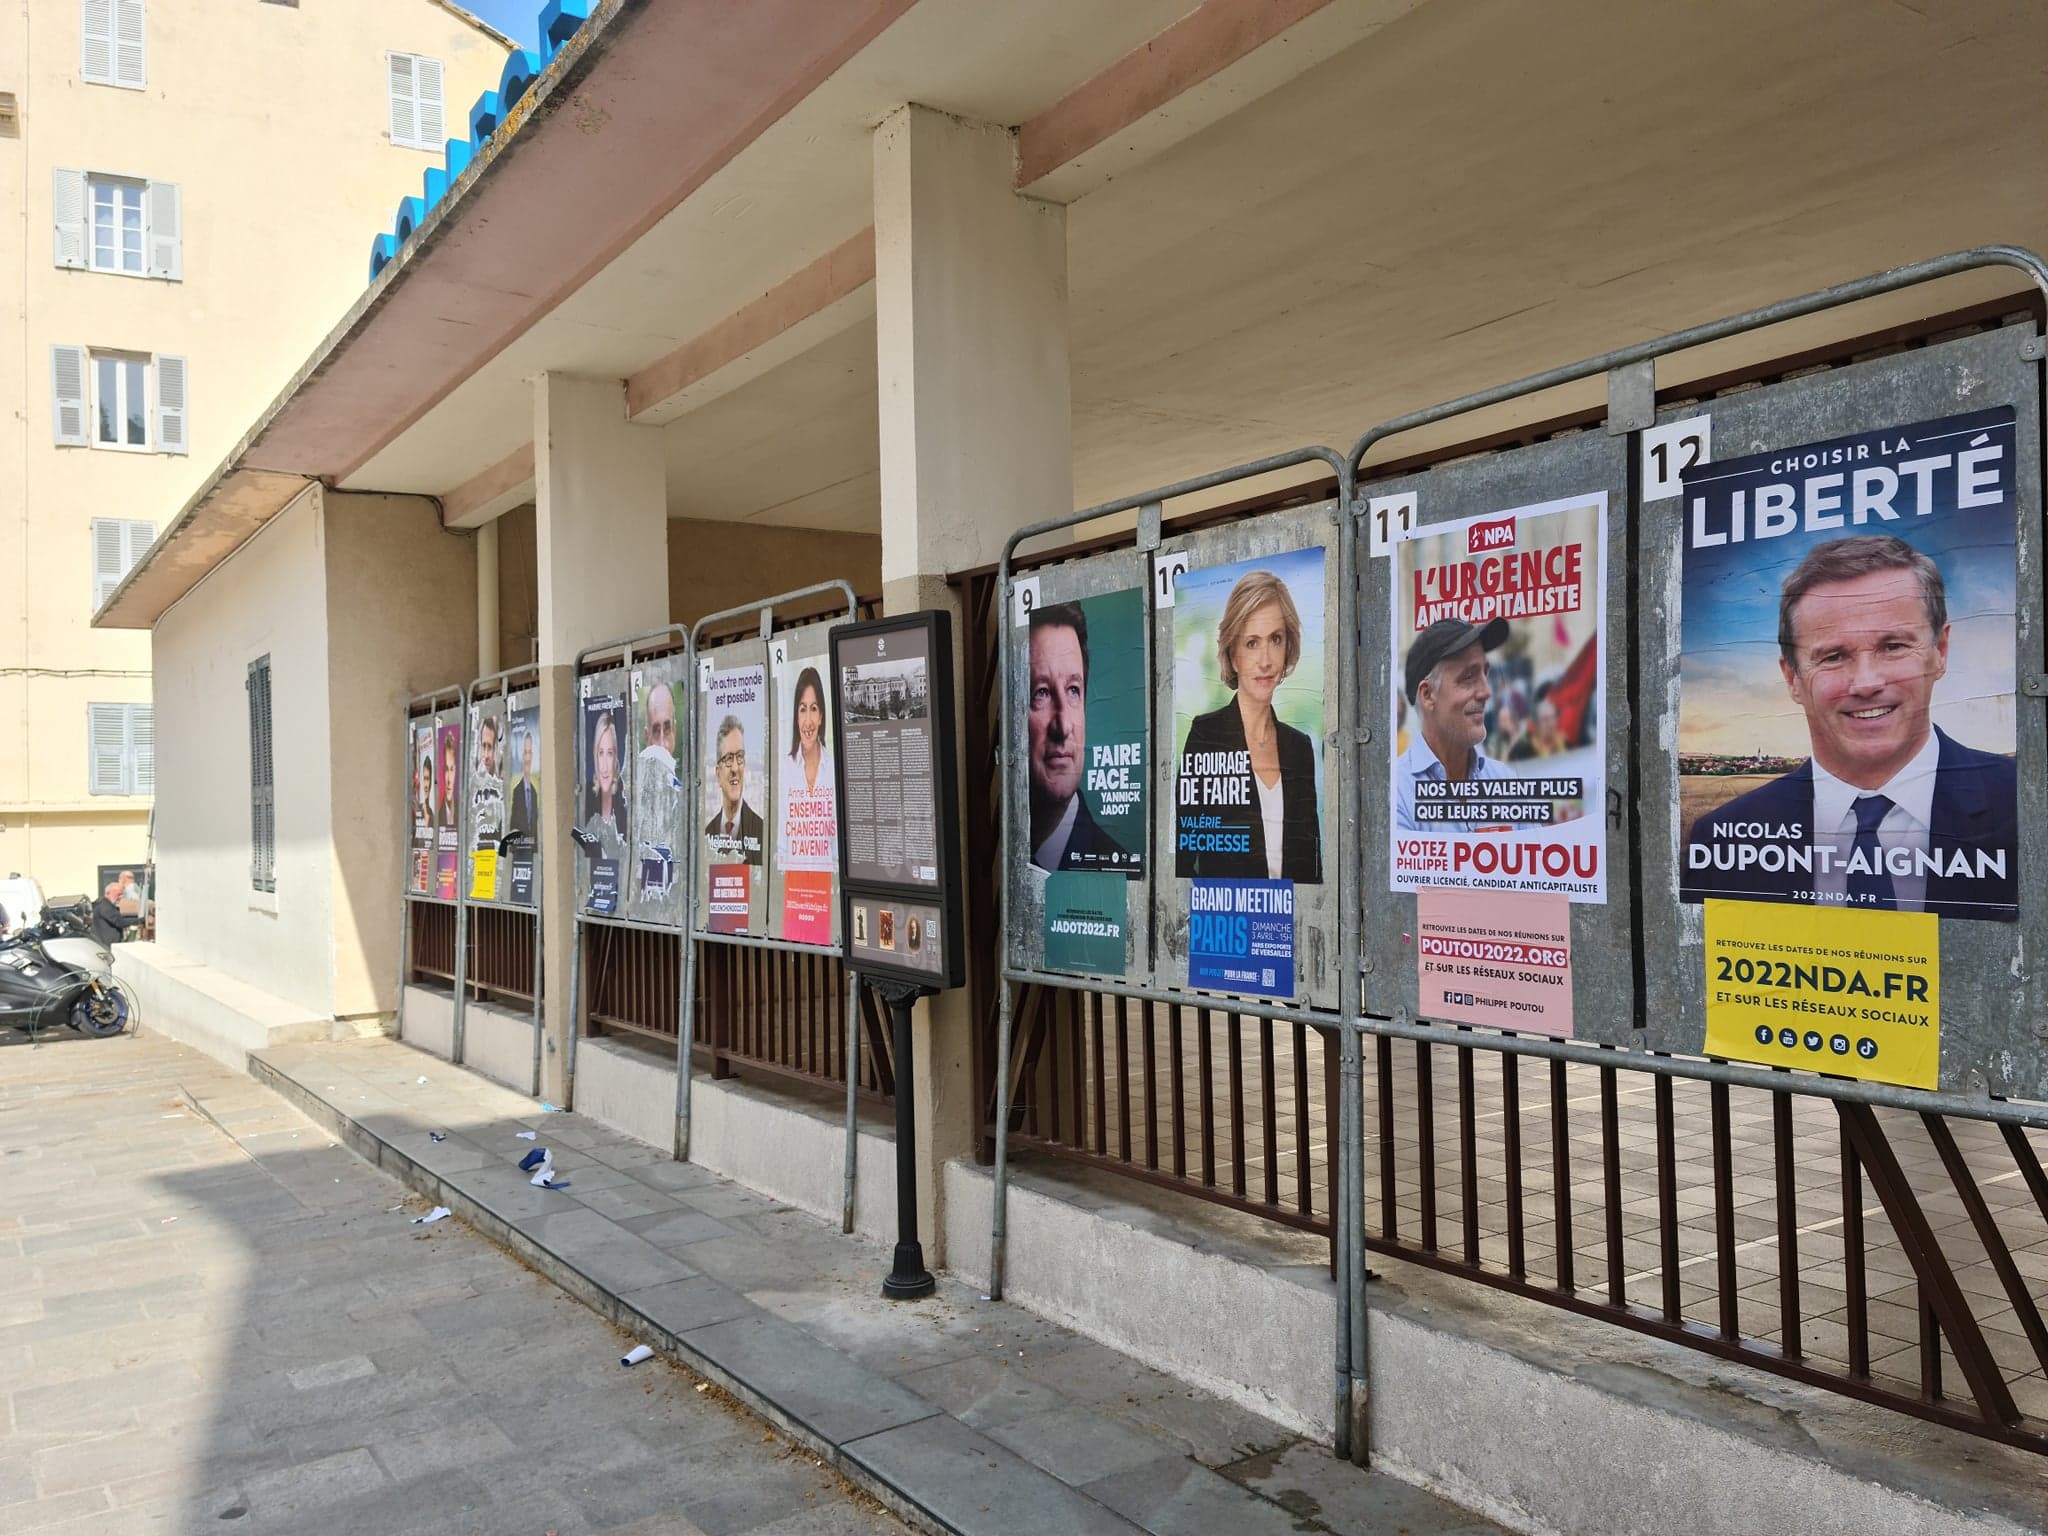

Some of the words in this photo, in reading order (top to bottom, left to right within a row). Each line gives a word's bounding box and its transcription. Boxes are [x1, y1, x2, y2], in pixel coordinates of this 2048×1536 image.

[1650, 435, 1700, 484] 12
[1771, 444, 1870, 475] CHOISIR
[1881, 437, 1911, 456] LA
[1692, 432, 2004, 548] LIBERTÉ
[1376, 505, 1410, 543] 11
[1484, 525, 1514, 546] NPA
[1414, 543, 1582, 601] L'URGENCE
[1022, 588, 1033, 615] 9
[1416, 584, 1579, 629] ANTICAPITALISTE
[709, 676, 718, 690] Un
[719, 675, 737, 689] autre
[738, 673, 762, 687] monde
[716, 692, 726, 705] est
[727, 688, 756, 708] possible
[1093, 743, 1141, 767] FAIRE
[1180, 753, 1192, 776] LE
[1195, 751, 1250, 775] COURAGE
[1088, 768, 1129, 791] FACE
[1417, 782, 1446, 797] NOS
[1450, 782, 1479, 797] VIES
[1482, 781, 1536, 796] VALENT
[1541, 781, 1577, 796] PLUS
[1101, 791, 1141, 803] YANNICK
[1180, 777, 1198, 806] DE
[1203, 776, 1250, 805] FAIRE
[789, 801, 832, 818] ENSEMBLE
[1101, 804, 1130, 815] JADOT
[1417, 805, 1443, 821] QUE
[1448, 805, 1487, 820] LEURS
[1492, 805, 1550, 820] PROFITS
[786, 820, 836, 836] CHANGEONS
[1180, 813, 1221, 828] VALÉRIE
[1713, 822, 1803, 839] NICOLAS
[792, 840, 829, 856] D'AVENIR
[1179, 830, 1250, 853] PÉCRESSE
[1397, 840, 1447, 857] VOTEZ
[1397, 858, 1448, 871] PHILIPPE
[1454, 842, 1598, 878] POUTOU
[1688, 843, 2007, 879] DUPONT-AIGNAN
[1397, 875, 1431, 885] OUVRIER
[1472, 878, 1517, 889] CANDIDAT
[1520, 881, 1598, 893] ANTICAPITALISTE
[1191, 887, 1232, 911] GRAND
[1235, 888, 1292, 914] MEETING
[1792, 890, 1877, 903] 2022NDA.FR
[1050, 920, 1119, 937] JADOT2022.FR
[1190, 914, 1248, 954] PARIS
[1252, 921, 1291, 932] DIMANCHE
[1257, 932, 1274, 940] AVRIL
[1280, 933, 1292, 941] 15H
[1422, 924, 1456, 933] RETROUVEZ
[1457, 926, 1467, 934] LES
[1468, 927, 1486, 936] DATES
[1498, 930, 1512, 938] NOS
[1514, 929, 1549, 941] RÉUNIONS
[1551, 934, 1565, 942] SUR
[1260, 949, 1292, 957] VERSAILLES
[1422, 938, 1566, 967] POUTOU2022.ORG
[1716, 939, 1766, 951] RETROUVEZ
[1768, 943, 1784, 952] LES
[1786, 945, 1814, 955] DATES
[1816, 947, 1829, 957] DE
[1831, 949, 1851, 959] NOS
[1854, 949, 1905, 963] RÉUNIONS
[1908, 955, 1927, 965] SUR
[1425, 962, 1434, 971] ET
[1436, 963, 1453, 973] SUR
[1456, 965, 1471, 975] LES
[1473, 965, 1515, 980] RÉSEAUX
[1518, 972, 1564, 985] SOCIAUX
[1716, 957, 1929, 1003] 2022NDA.FR
[1475, 997, 1508, 1008] PHILIPPE
[1510, 1002, 1544, 1013] POUTOU
[1716, 991, 1730, 1002] ET
[1735, 993, 1761, 1006] SUR
[1765, 997, 1788, 1009] LES
[1792, 998, 1857, 1018] RÉSEAUX
[1861, 1009, 1929, 1027] SOCIAUX
